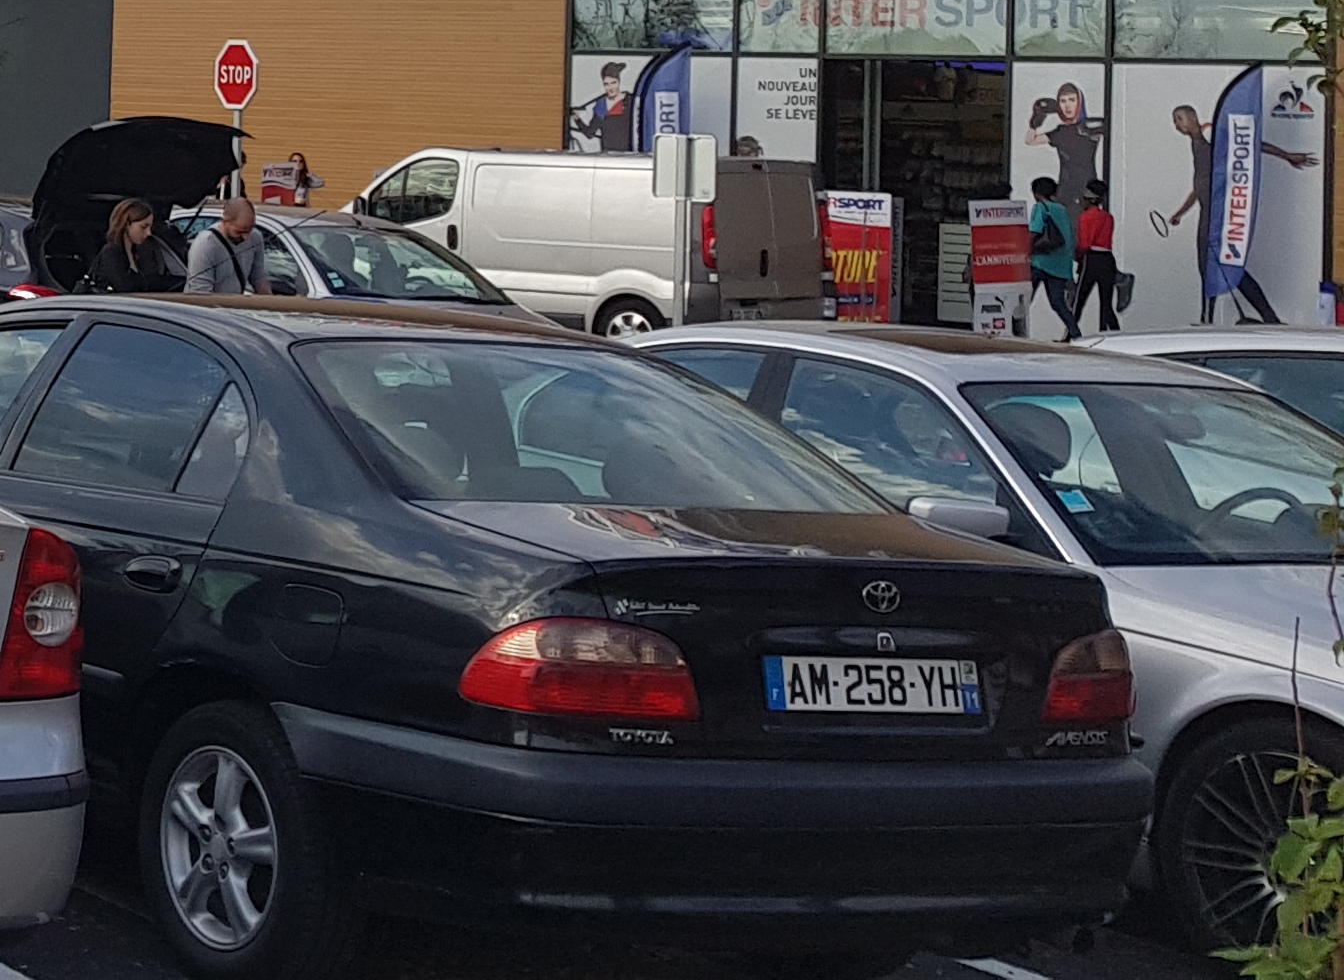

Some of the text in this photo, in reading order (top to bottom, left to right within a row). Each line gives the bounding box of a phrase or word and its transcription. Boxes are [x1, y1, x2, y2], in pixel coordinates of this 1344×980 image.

[220, 65, 252, 84] STOP
[799, 67, 817, 78] UN
[757, 80, 817, 92] NOUVEAU
[783, 95, 817, 106] JOUR
[766, 108, 782, 119] SE
[1227, 121, 1251, 242] INTERSPORT
[828, 197, 885, 211] RSPORT
[789, 663, 960, 707] AM-258-YH
[609, 727, 674, 745] TOYOTA
